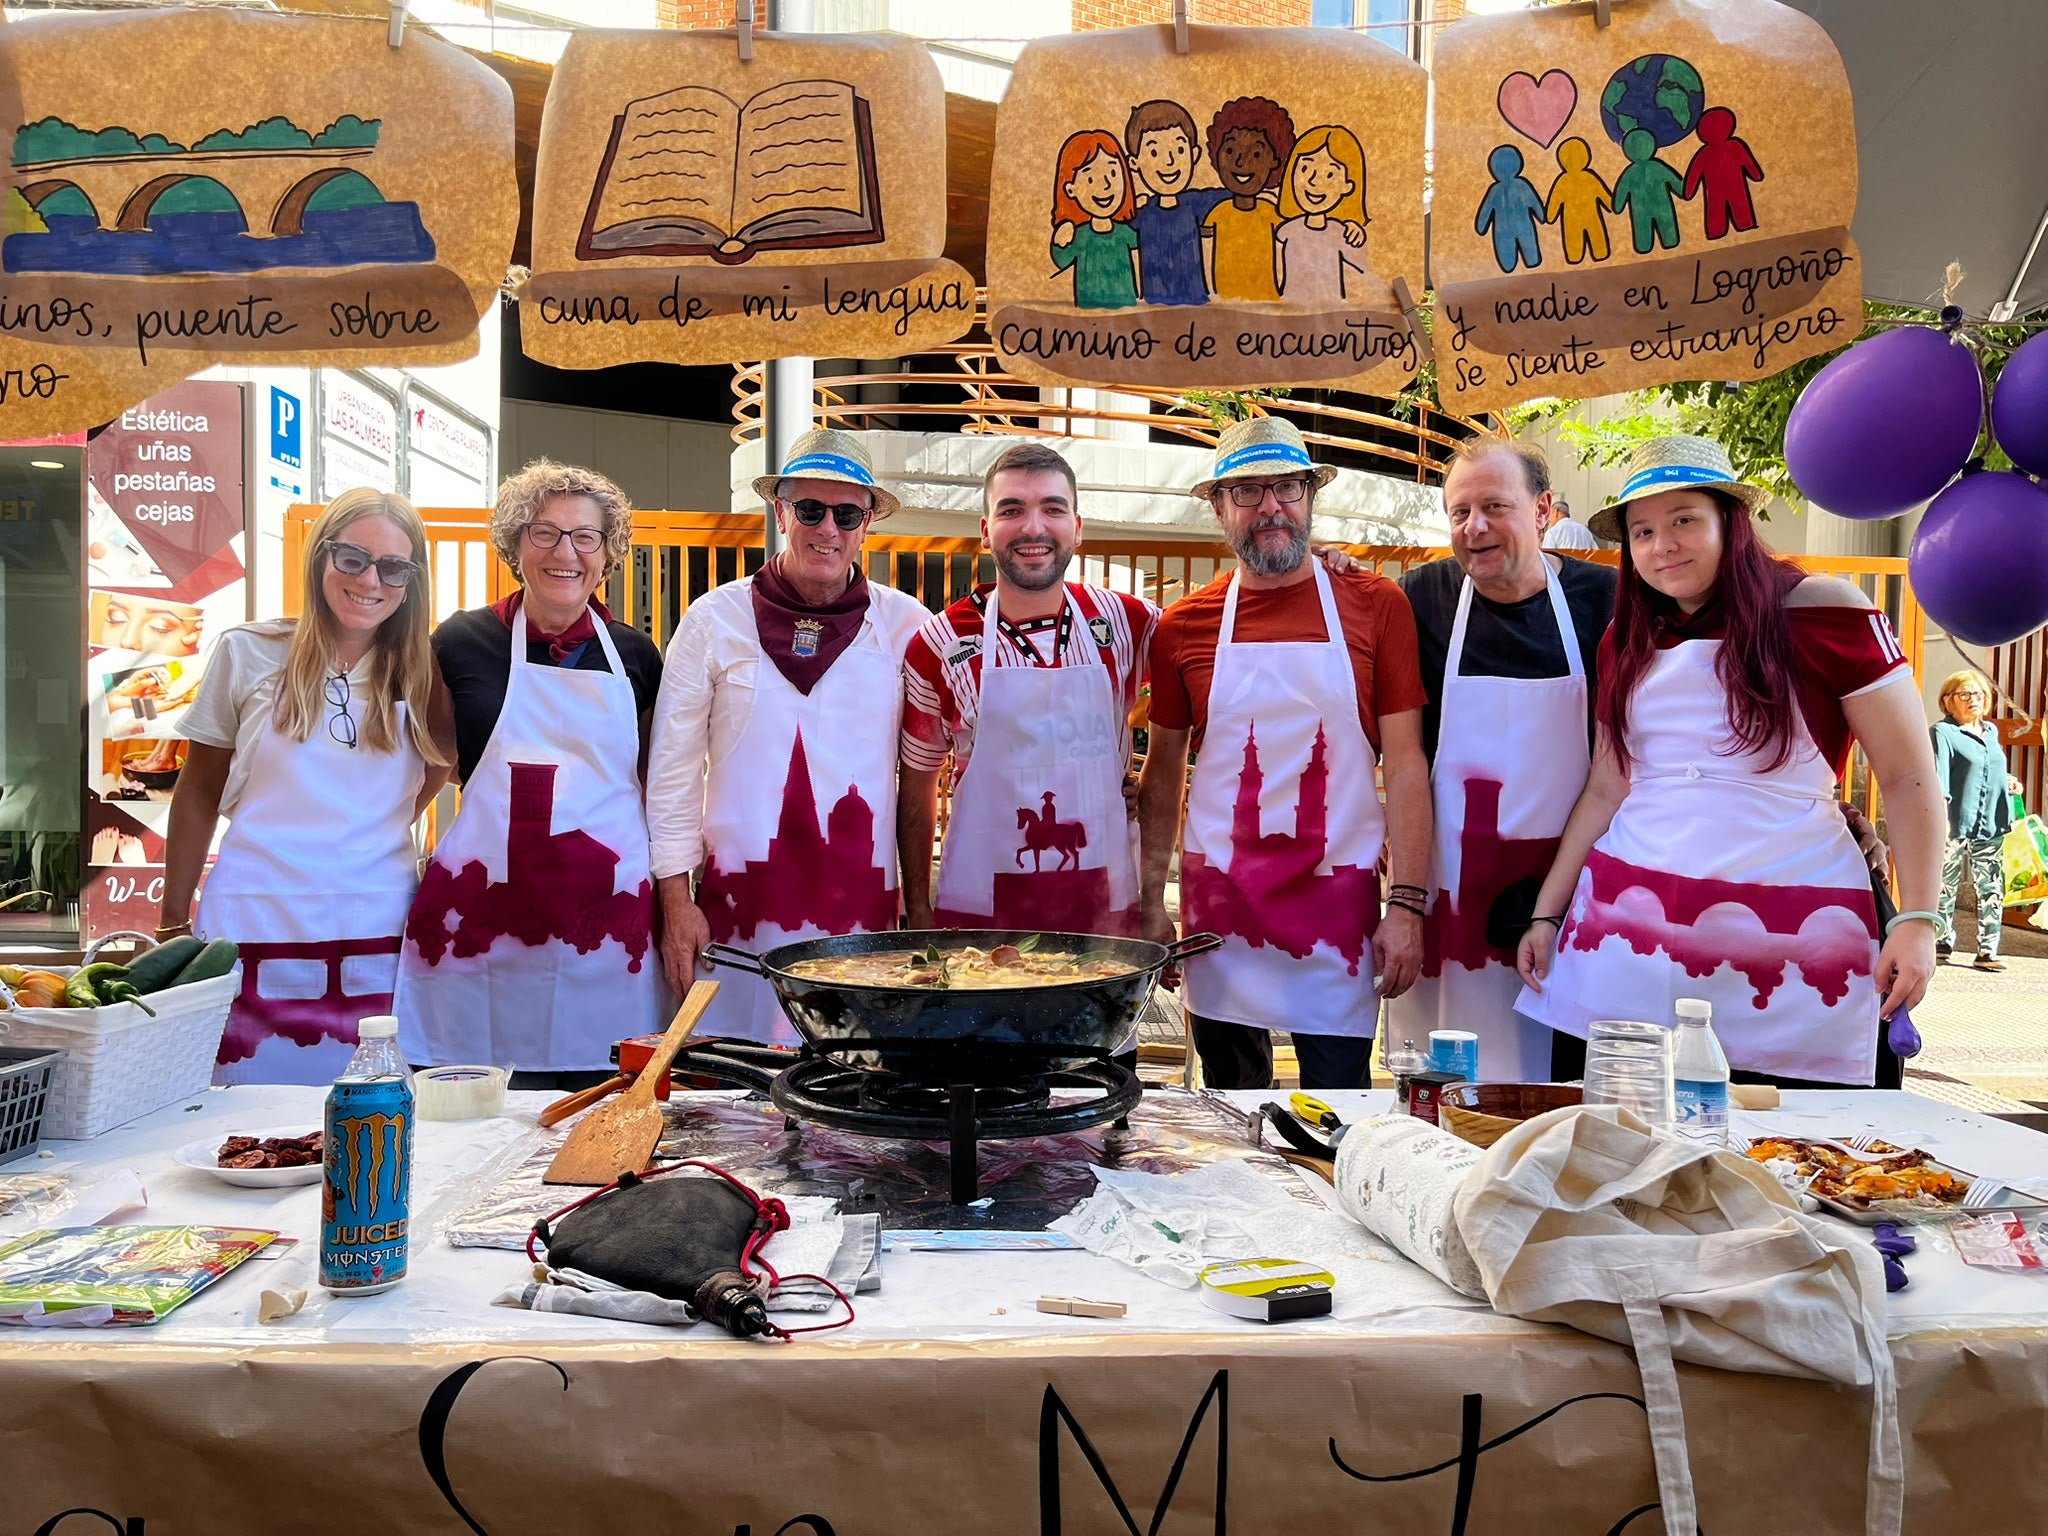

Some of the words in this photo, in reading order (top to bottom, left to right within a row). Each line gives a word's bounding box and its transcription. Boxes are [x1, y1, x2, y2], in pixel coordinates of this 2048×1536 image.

[540, 295, 640, 327] cuna
[658, 274, 713, 327] de
[745, 284, 799, 323] mi
[824, 276, 970, 336] lengua
[1446, 303, 1477, 352] y
[1495, 282, 1599, 325] nadie
[1623, 284, 1669, 311] en
[1690, 247, 1854, 315] Logroño
[137, 294, 298, 366] puente
[329, 291, 440, 339] sobre
[1174, 320, 1216, 361] de
[1236, 317, 1418, 373] encuentros
[1505, 334, 1606, 387] siente
[1630, 306, 1846, 370] extranjero
[121, 409, 209, 433] Estética
[277, 395, 295, 438] P
[331, 405, 347, 431] LAS
[349, 416, 392, 454] PALMERAS
[138, 441, 192, 462] uñas
[114, 471, 216, 495] pestañas
[135, 501, 195, 526] cejas
[948, 647, 976, 667] PUMA
[330, 1219, 409, 1245] JUICED
[1276, 1285, 1309, 1296] plico
